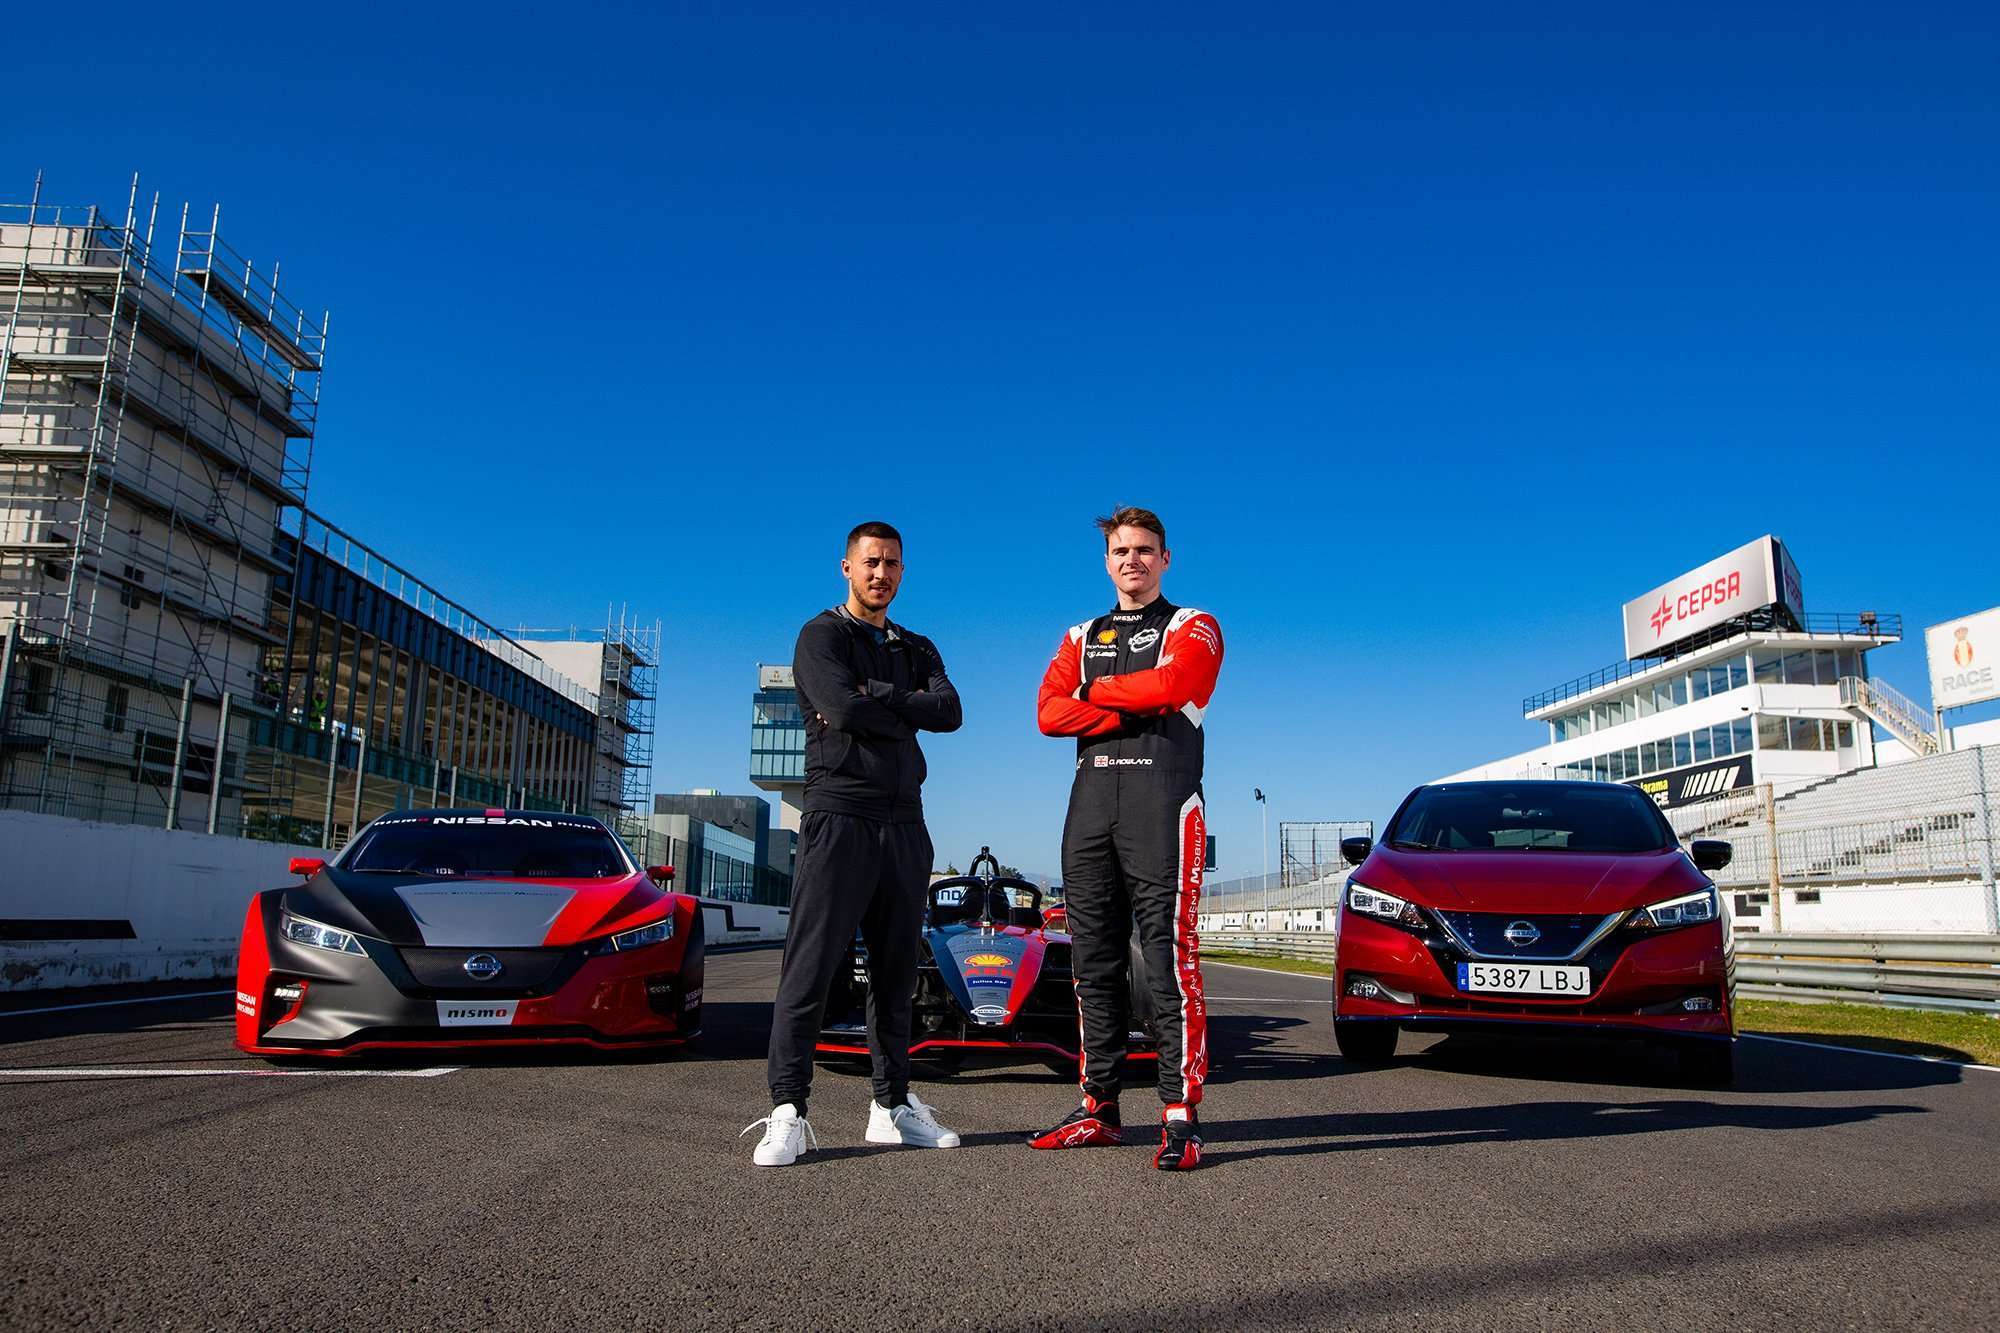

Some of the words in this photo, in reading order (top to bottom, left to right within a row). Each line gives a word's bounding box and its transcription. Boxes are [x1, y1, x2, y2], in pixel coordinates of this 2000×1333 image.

[1677, 571, 1740, 621] CEPSA
[1942, 667, 1993, 693] RACE
[1116, 758, 1153, 766] ROWLAND
[433, 817, 553, 828] NISSAN
[1190, 815, 1202, 884] MOBILITY
[1474, 967, 1531, 989] 5387
[1540, 970, 1584, 991] LBJ
[237, 991, 256, 1006] NISSAN
[447, 1009, 508, 1018] nismo
